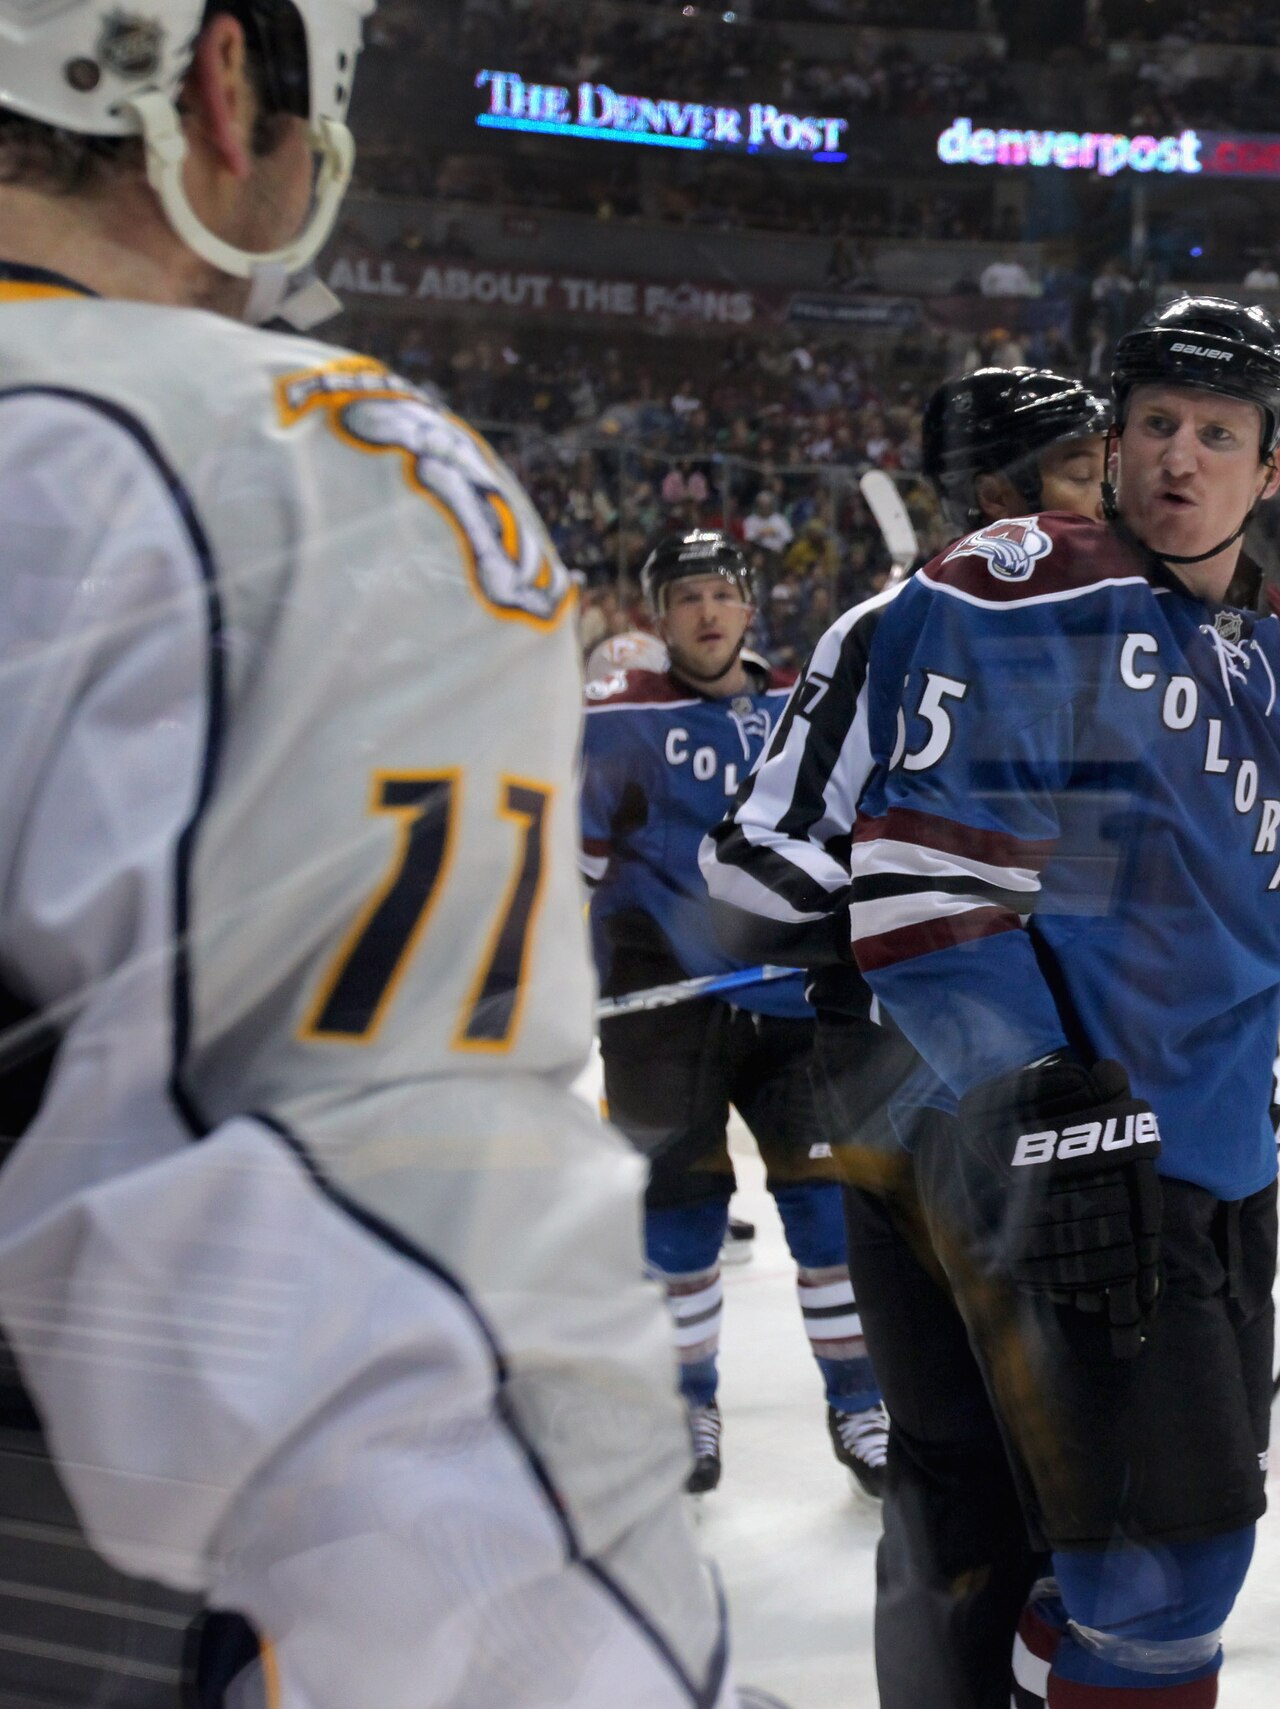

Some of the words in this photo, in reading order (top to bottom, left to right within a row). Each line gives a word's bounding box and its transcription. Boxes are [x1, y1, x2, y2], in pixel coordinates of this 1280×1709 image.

[475, 69, 571, 122] THE
[577, 82, 743, 144] DENVER
[748, 103, 848, 152] POST
[328, 258, 410, 296] ALL
[417, 267, 551, 308] ABOUT
[560, 277, 636, 315] THE
[1169, 342, 1234, 362] BAUER
[1010, 1111, 1162, 1167] BAUE
